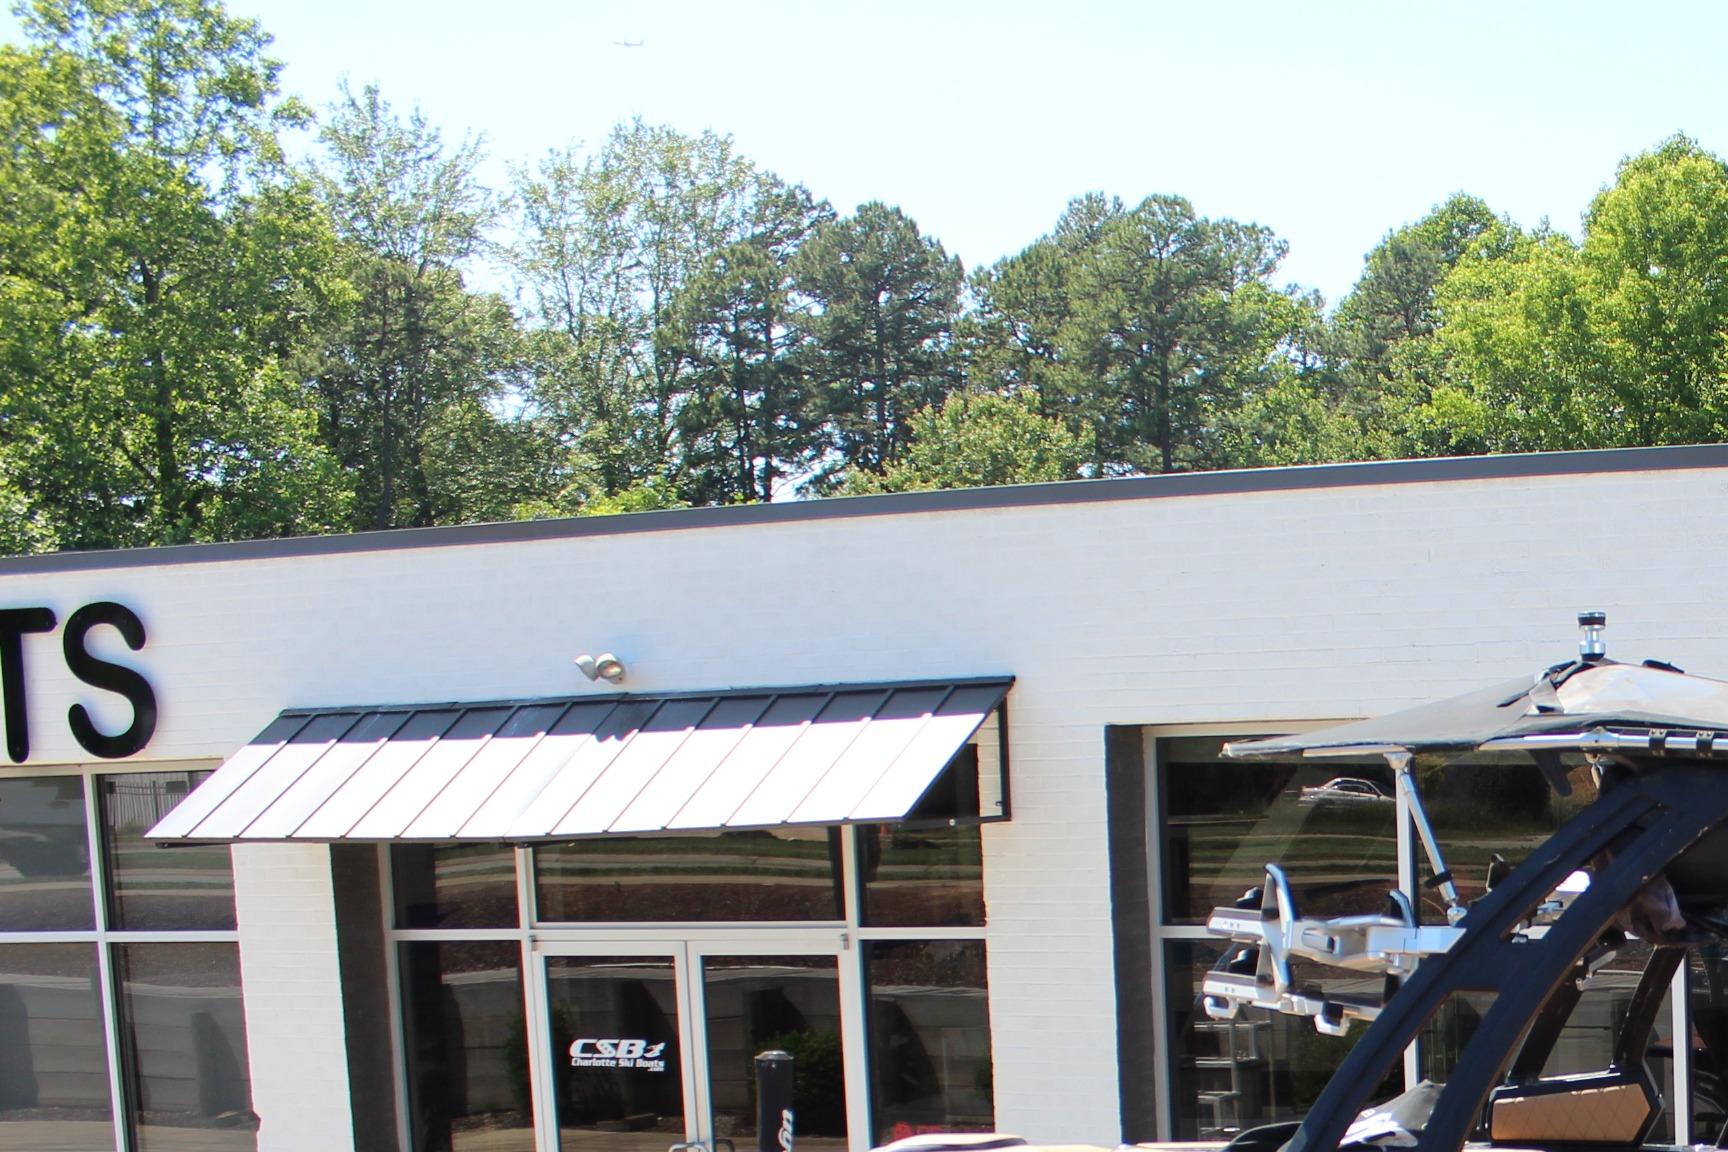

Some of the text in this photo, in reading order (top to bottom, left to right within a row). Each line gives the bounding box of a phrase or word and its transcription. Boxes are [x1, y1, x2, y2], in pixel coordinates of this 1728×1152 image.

[0, 601, 158, 764] TS
[569, 1038, 647, 1058] CSB
[571, 1058, 665, 1069] Charlotte Ski Boats
